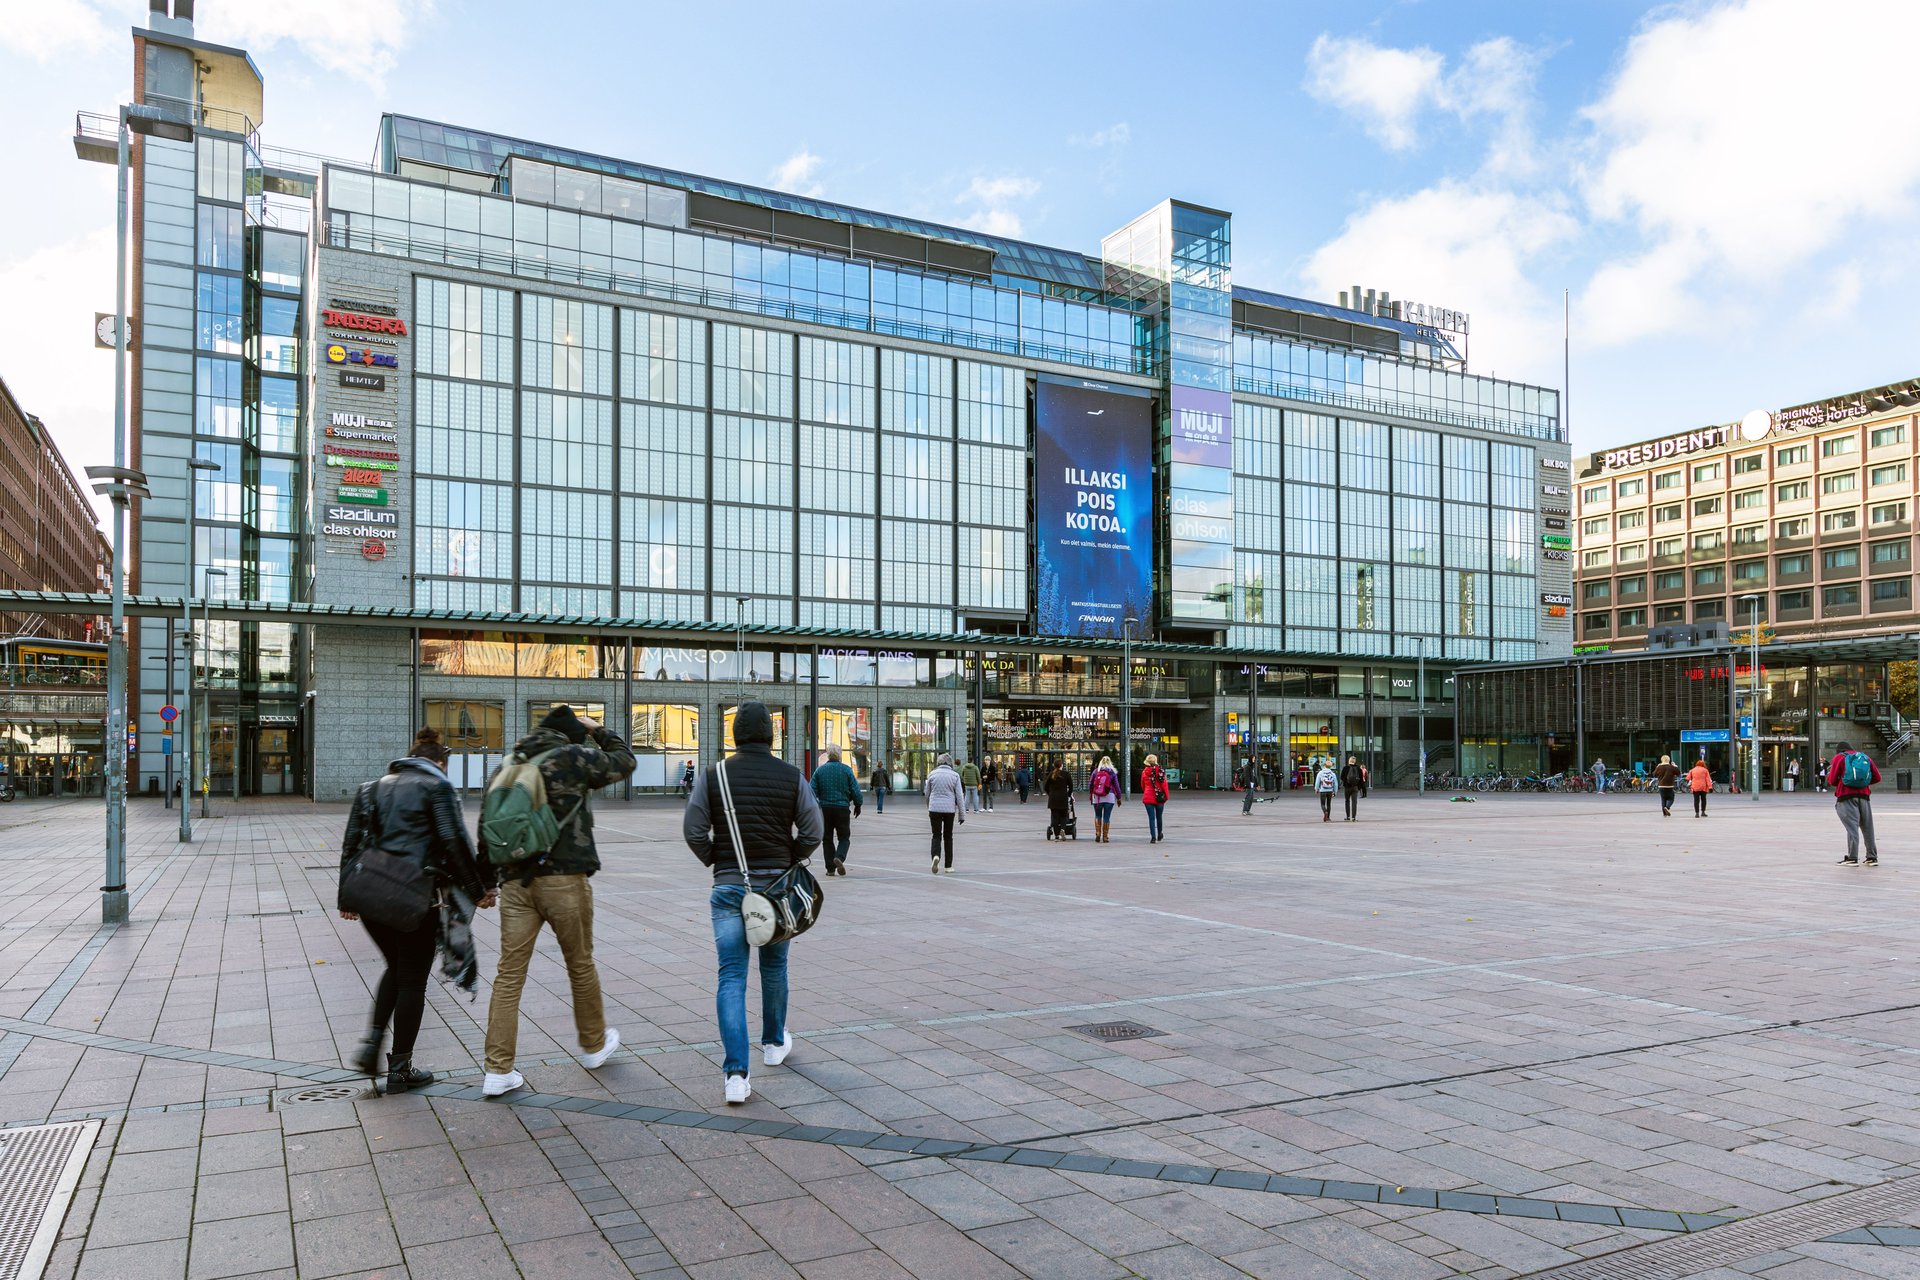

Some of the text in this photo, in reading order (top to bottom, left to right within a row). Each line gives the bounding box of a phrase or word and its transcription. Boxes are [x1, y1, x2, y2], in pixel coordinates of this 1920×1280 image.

[1403, 300, 1470, 335] KAMPPI
[330, 332, 396, 345] TOMMY HILFIGER
[346, 376, 380, 386] HEMTEX
[333, 412, 366, 428] MUJI
[1181, 408, 1222, 434] MUJI
[1775, 405, 1823, 421] ORIGINAL
[1776, 405, 1867, 431] BY SOKOS HOTELS
[334, 427, 398, 444] Supermarket
[324, 445, 400, 461] Dressmann
[1605, 424, 1739, 469] PRESIDENTTI
[1544, 459, 1569, 470] BIK BOK
[343, 468, 382, 485] alepa
[1065, 467, 1127, 490] ILLAKSI
[1545, 485, 1558, 495] MUJI
[1077, 491, 1116, 511] POIS
[1174, 495, 1208, 514] clas
[328, 507, 395, 523] stadium
[1066, 512, 1127, 534] KOTOA.
[323, 523, 397, 539] clas ohlson
[1176, 520, 1228, 539] ohlson
[1547, 551, 1568, 560] KICKS
[1544, 594, 1571, 604] stadium
[1078, 614, 1116, 623] FINNAIR
[644, 647, 727, 664] MANGO
[818, 648, 914, 662] JACK JONES
[1392, 679, 1413, 688] VOLT
[1062, 705, 1109, 720] KAMPPI
